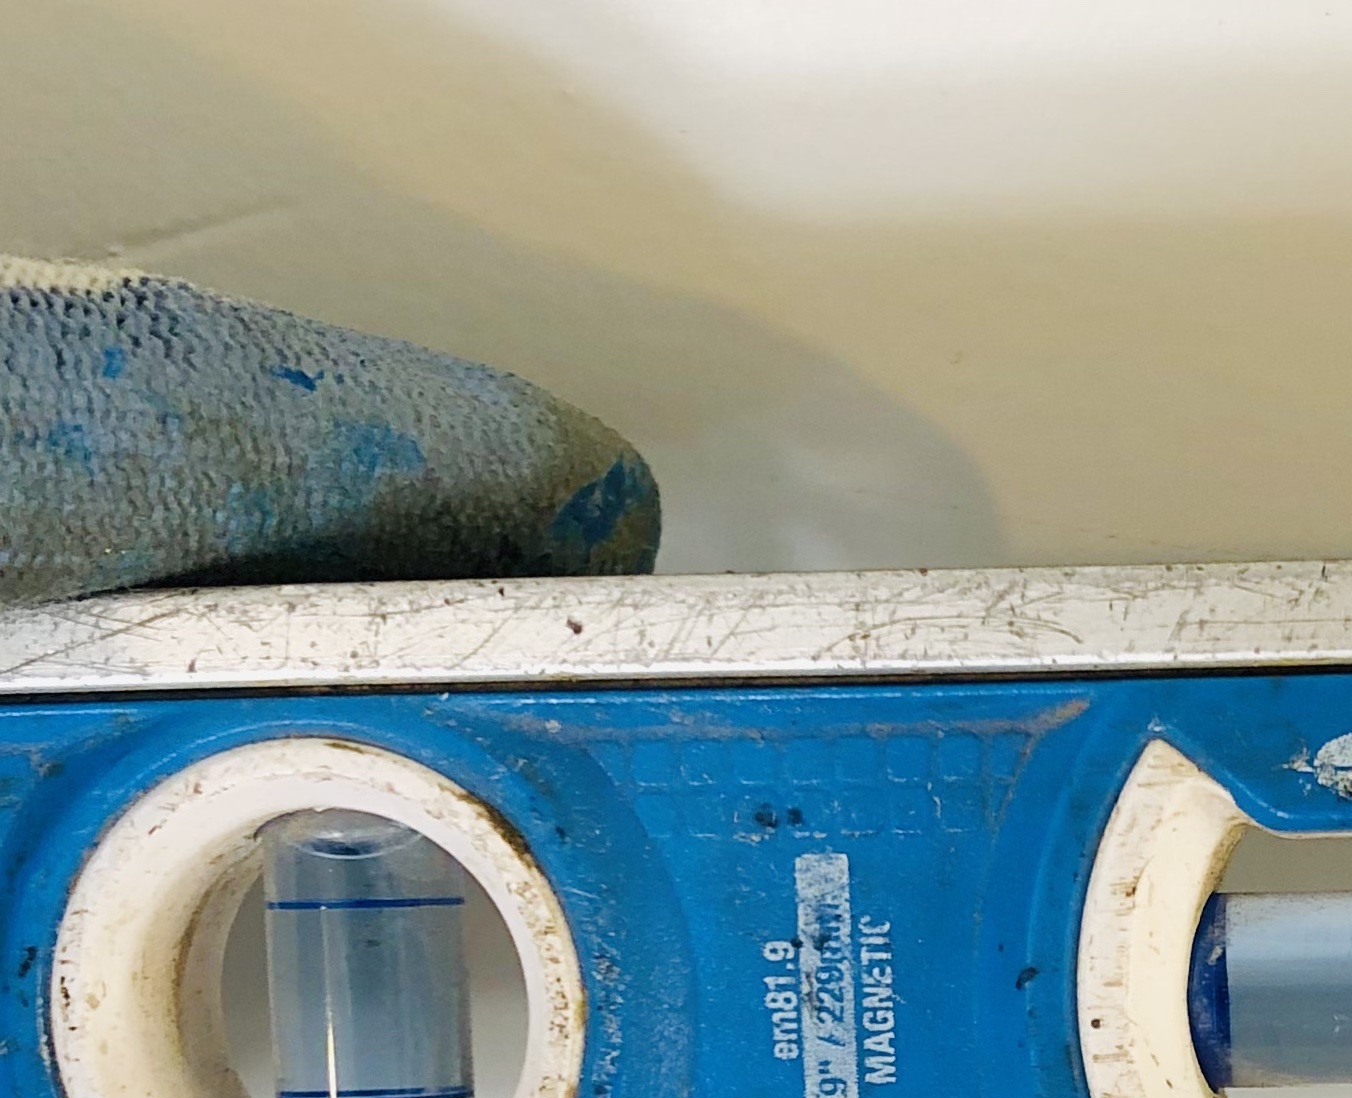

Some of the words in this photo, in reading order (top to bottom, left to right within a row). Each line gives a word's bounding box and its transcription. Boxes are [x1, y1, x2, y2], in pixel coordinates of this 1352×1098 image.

[762, 939, 800, 1060] em81.9
[857, 914, 899, 1085] MAGNETIC
[816, 1034, 847, 1048] /
[818, 1060, 849, 1097] 9"
